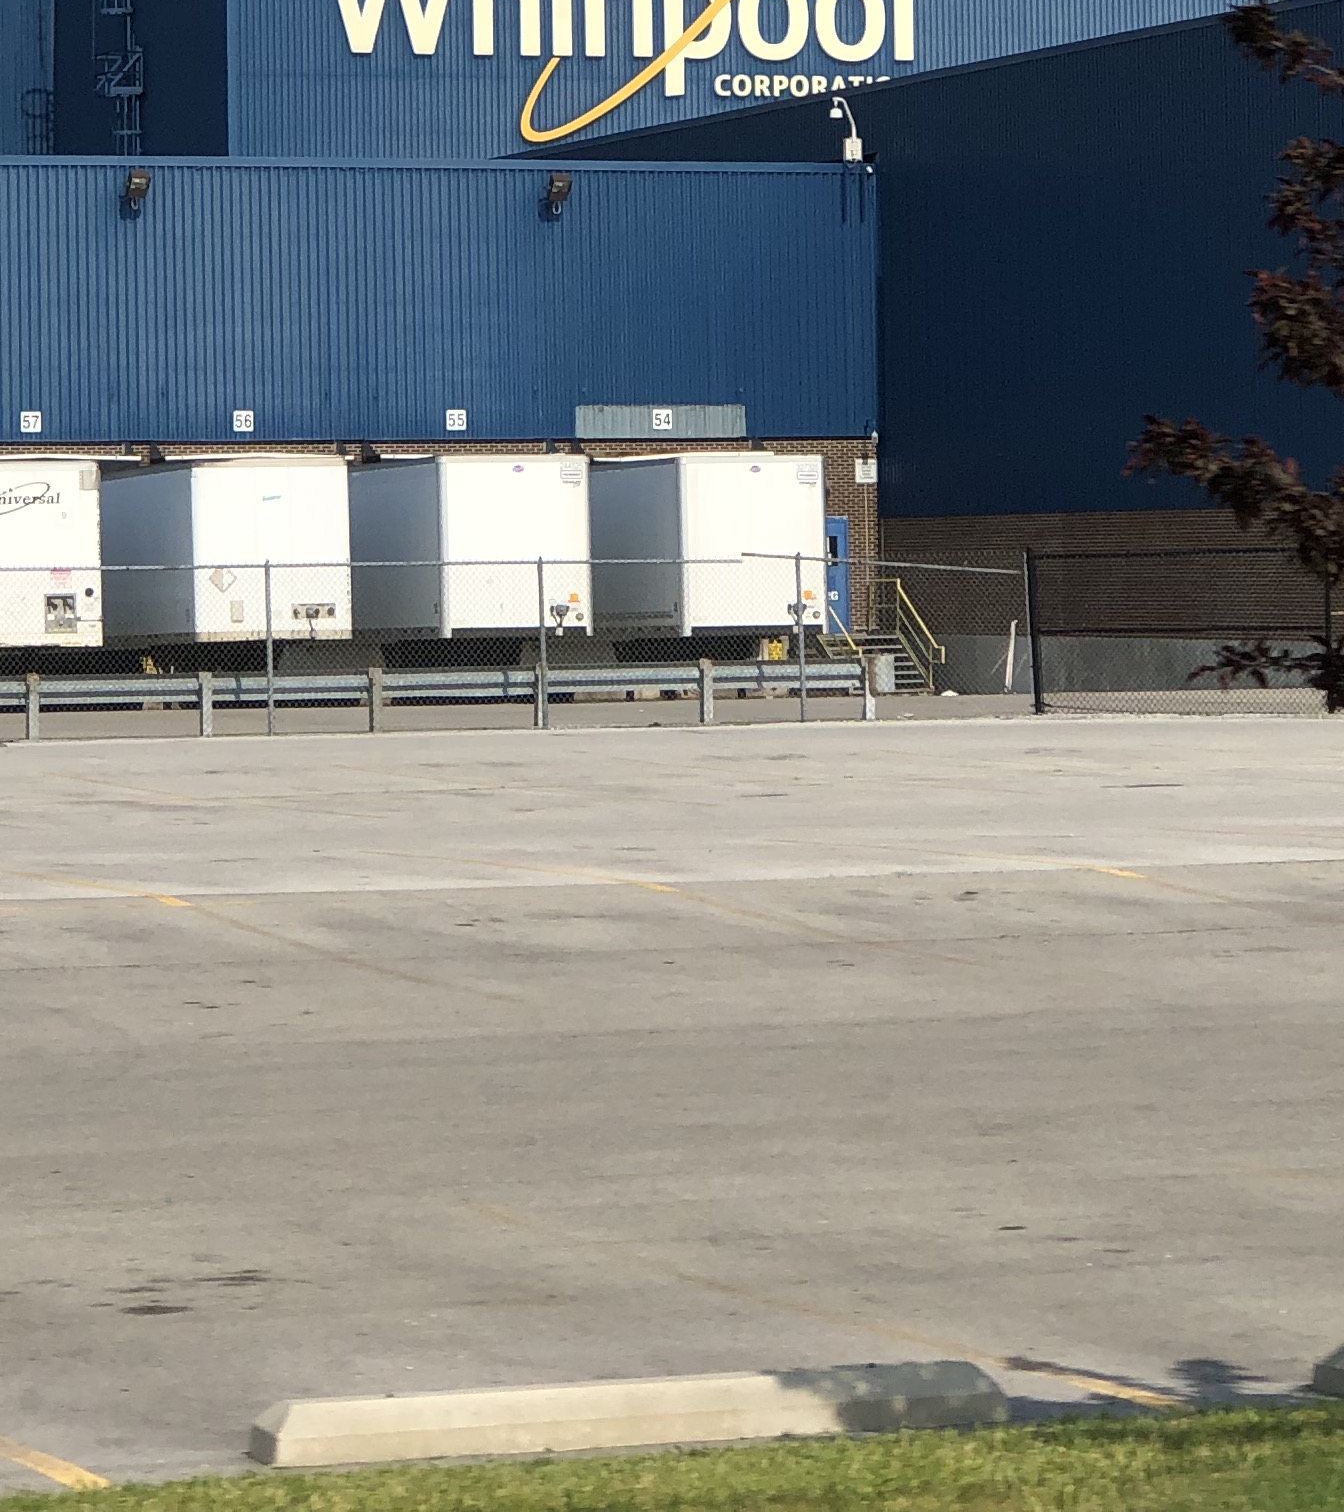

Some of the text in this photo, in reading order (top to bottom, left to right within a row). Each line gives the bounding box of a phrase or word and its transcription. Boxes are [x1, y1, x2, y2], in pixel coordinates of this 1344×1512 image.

[714, 74, 891, 97] CORPORAT
[22, 415, 40, 429] 57
[235, 414, 252, 428] 56
[448, 413, 465, 427] 55
[654, 413, 671, 427] 54
